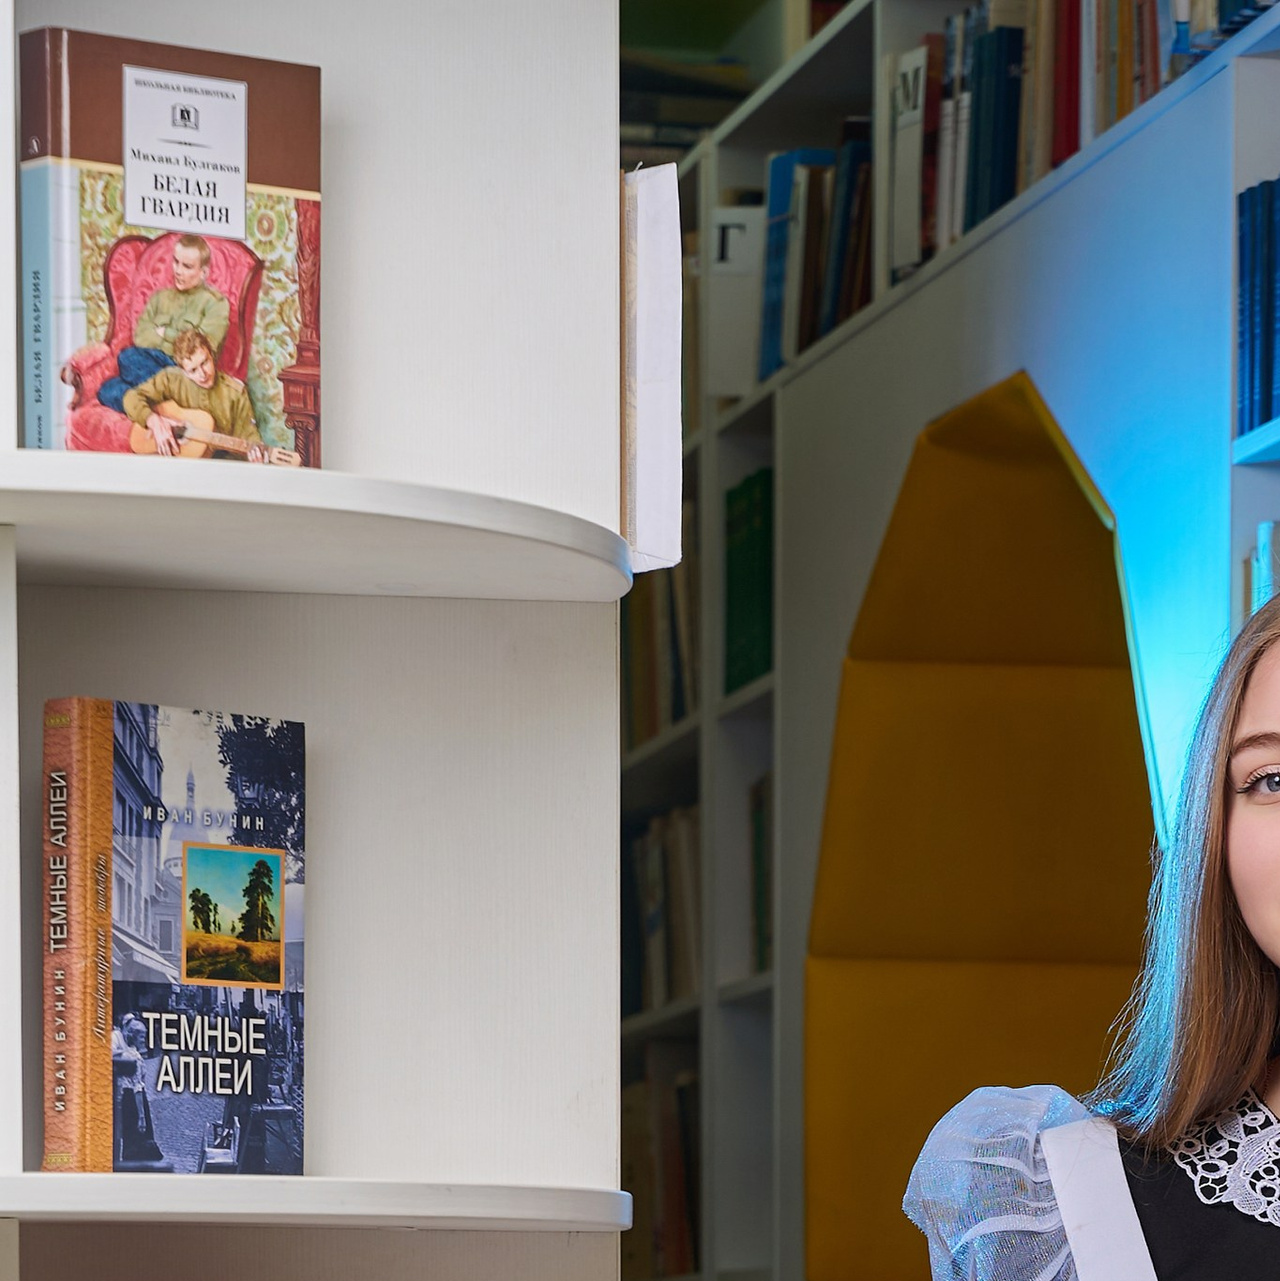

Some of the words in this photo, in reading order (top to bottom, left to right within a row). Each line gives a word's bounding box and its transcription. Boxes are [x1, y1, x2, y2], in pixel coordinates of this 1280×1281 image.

[131, 148, 180, 165] Михаил
[184, 155, 240, 174] Булгаков
[153, 173, 218, 199] БЕЛАЯ
[140, 196, 230, 224] ГВАРДИЯ
[716, 223, 746, 264] Г
[50, 771, 67, 848] АЛЛЕИ
[142, 804, 193, 826] ИВАН
[202, 808, 266, 831] БУНИН
[50, 855, 67, 953] ТЕМНЫЕ
[55, 970, 66, 1041] БУНИН
[142, 1011, 267, 1056] ТЕМНЫЕ
[55, 1053, 66, 1112] ИВАН
[156, 1054, 253, 1096] АЛЛЕИ
